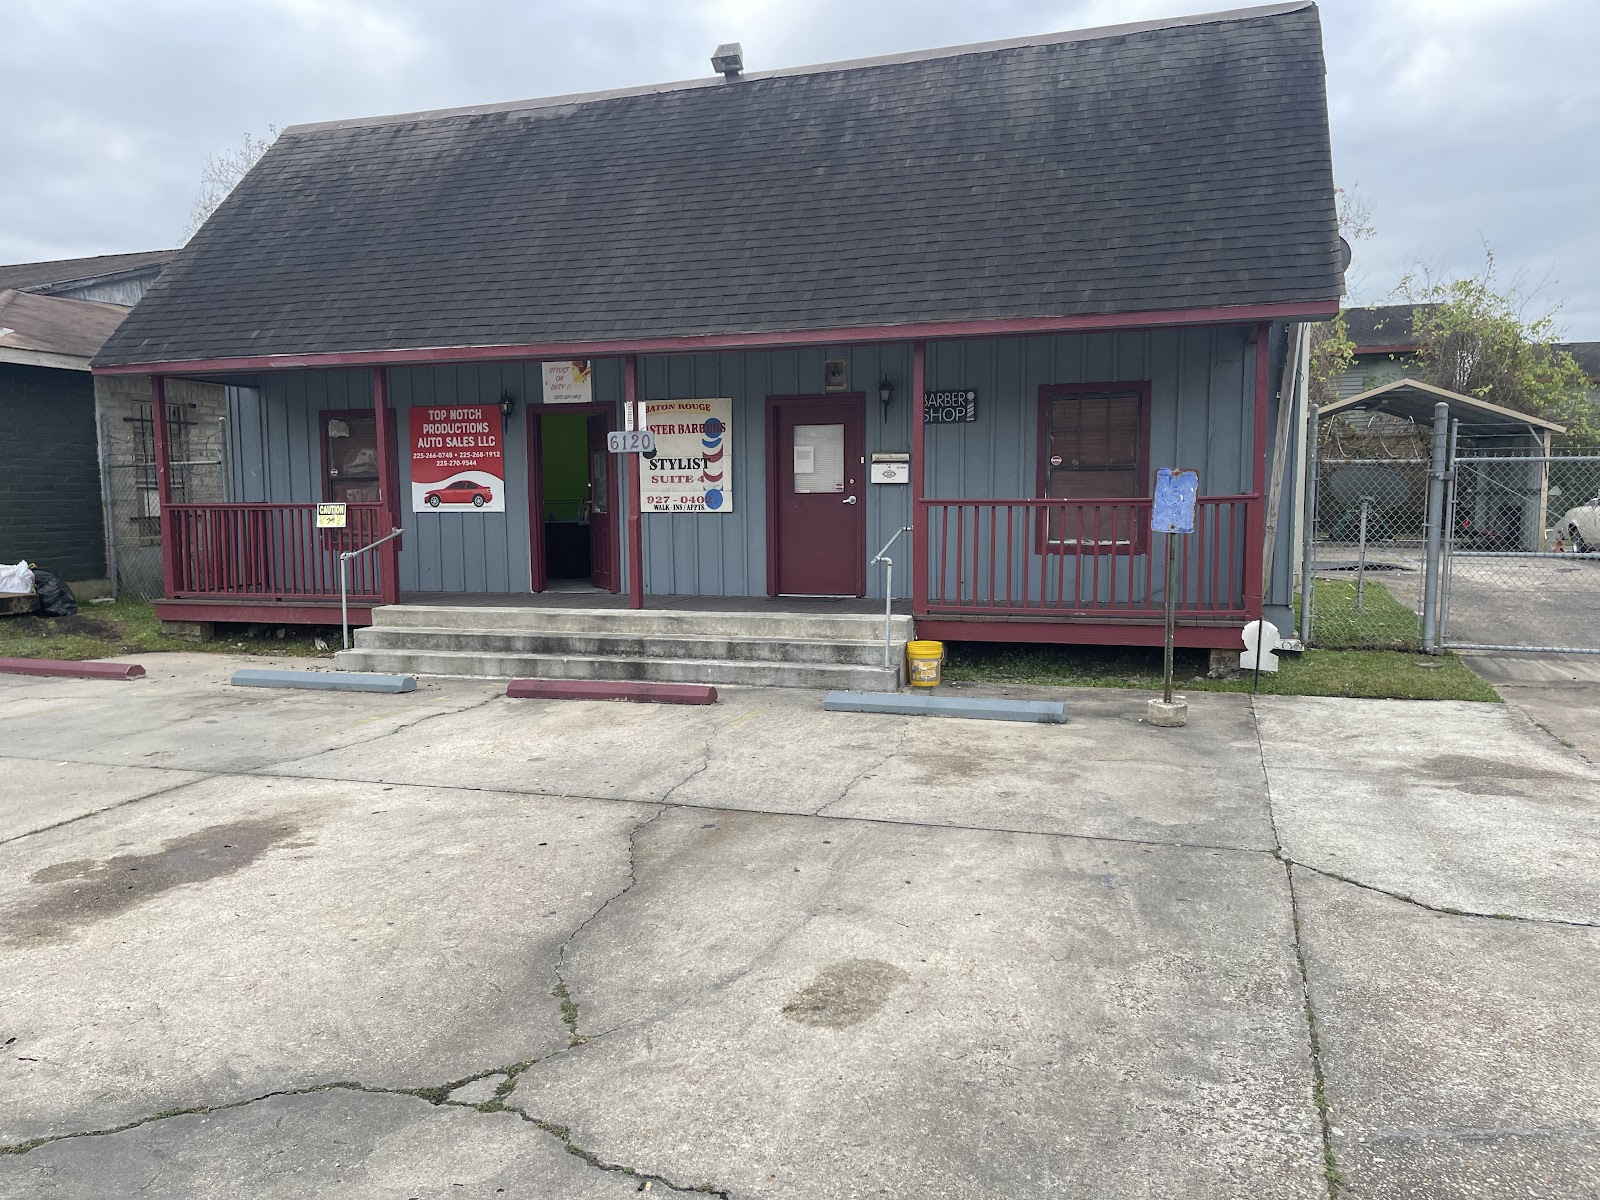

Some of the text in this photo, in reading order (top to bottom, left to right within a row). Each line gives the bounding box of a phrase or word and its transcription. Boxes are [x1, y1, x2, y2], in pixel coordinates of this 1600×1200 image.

[549, 366, 570, 374] STYLIST
[924, 392, 966, 407] BARBER
[646, 403, 711, 413] BATON ROUGE
[428, 409, 482, 421] TOP NOTCH
[924, 407, 966, 422] SHOP
[423, 422, 489, 434] PRODUCTIONS
[646, 423, 676, 435] STER
[418, 435, 496, 448] AUTO SALES LLC
[610, 434, 651, 451] 6120
[436, 459, 477, 467] 225-270-9544
[649, 458, 710, 471] STYLIST
[651, 475, 694, 484] SUITE
[320, 505, 344, 515] CAUTION
